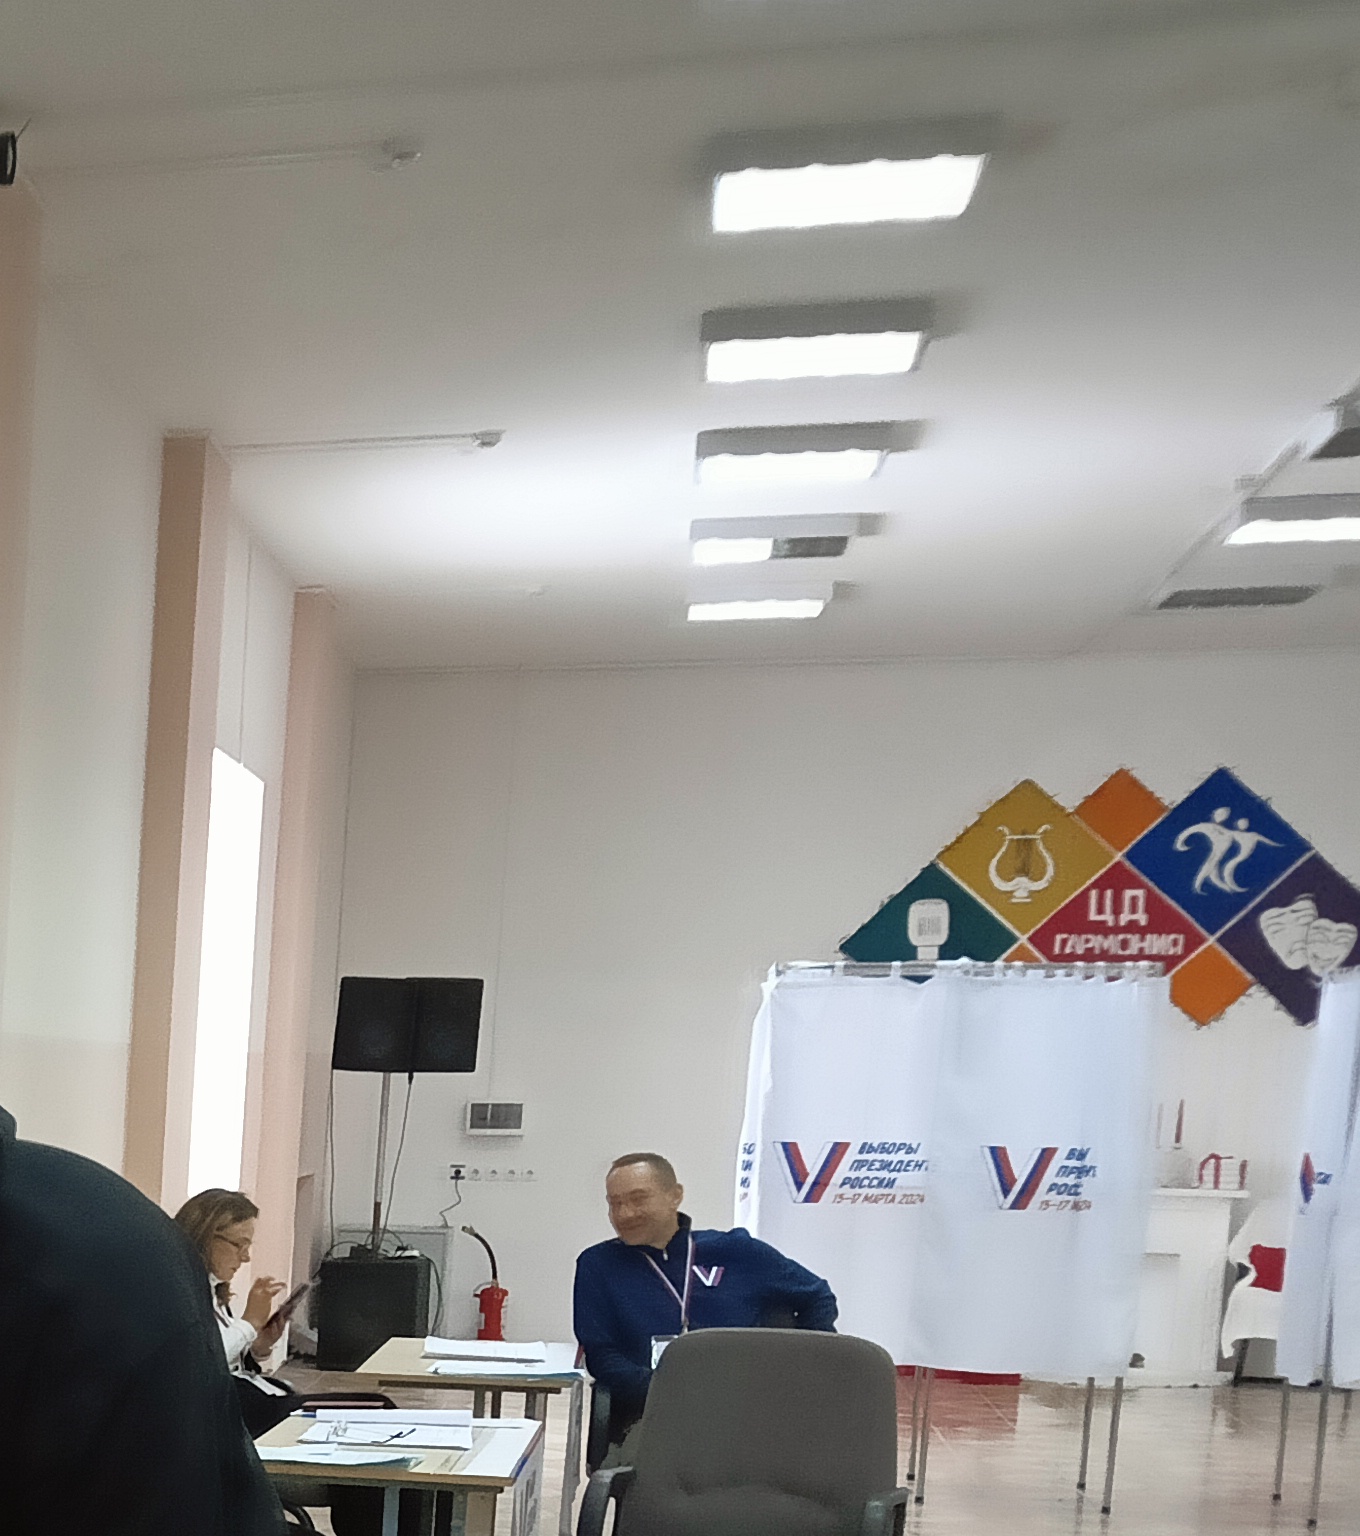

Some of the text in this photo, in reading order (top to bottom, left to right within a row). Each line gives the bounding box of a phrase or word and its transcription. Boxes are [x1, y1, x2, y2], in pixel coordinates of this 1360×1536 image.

[1088, 888, 1149, 927] ЦД
[1053, 933, 1185, 955] ГАРМОНИЯ
[857, 1141, 921, 1155] ВЫБОРЫ
[838, 1175, 899, 1190] РОССИИ
[862, 1193, 896, 1205] МАРТА
[897, 1193, 926, 1205] 2024
